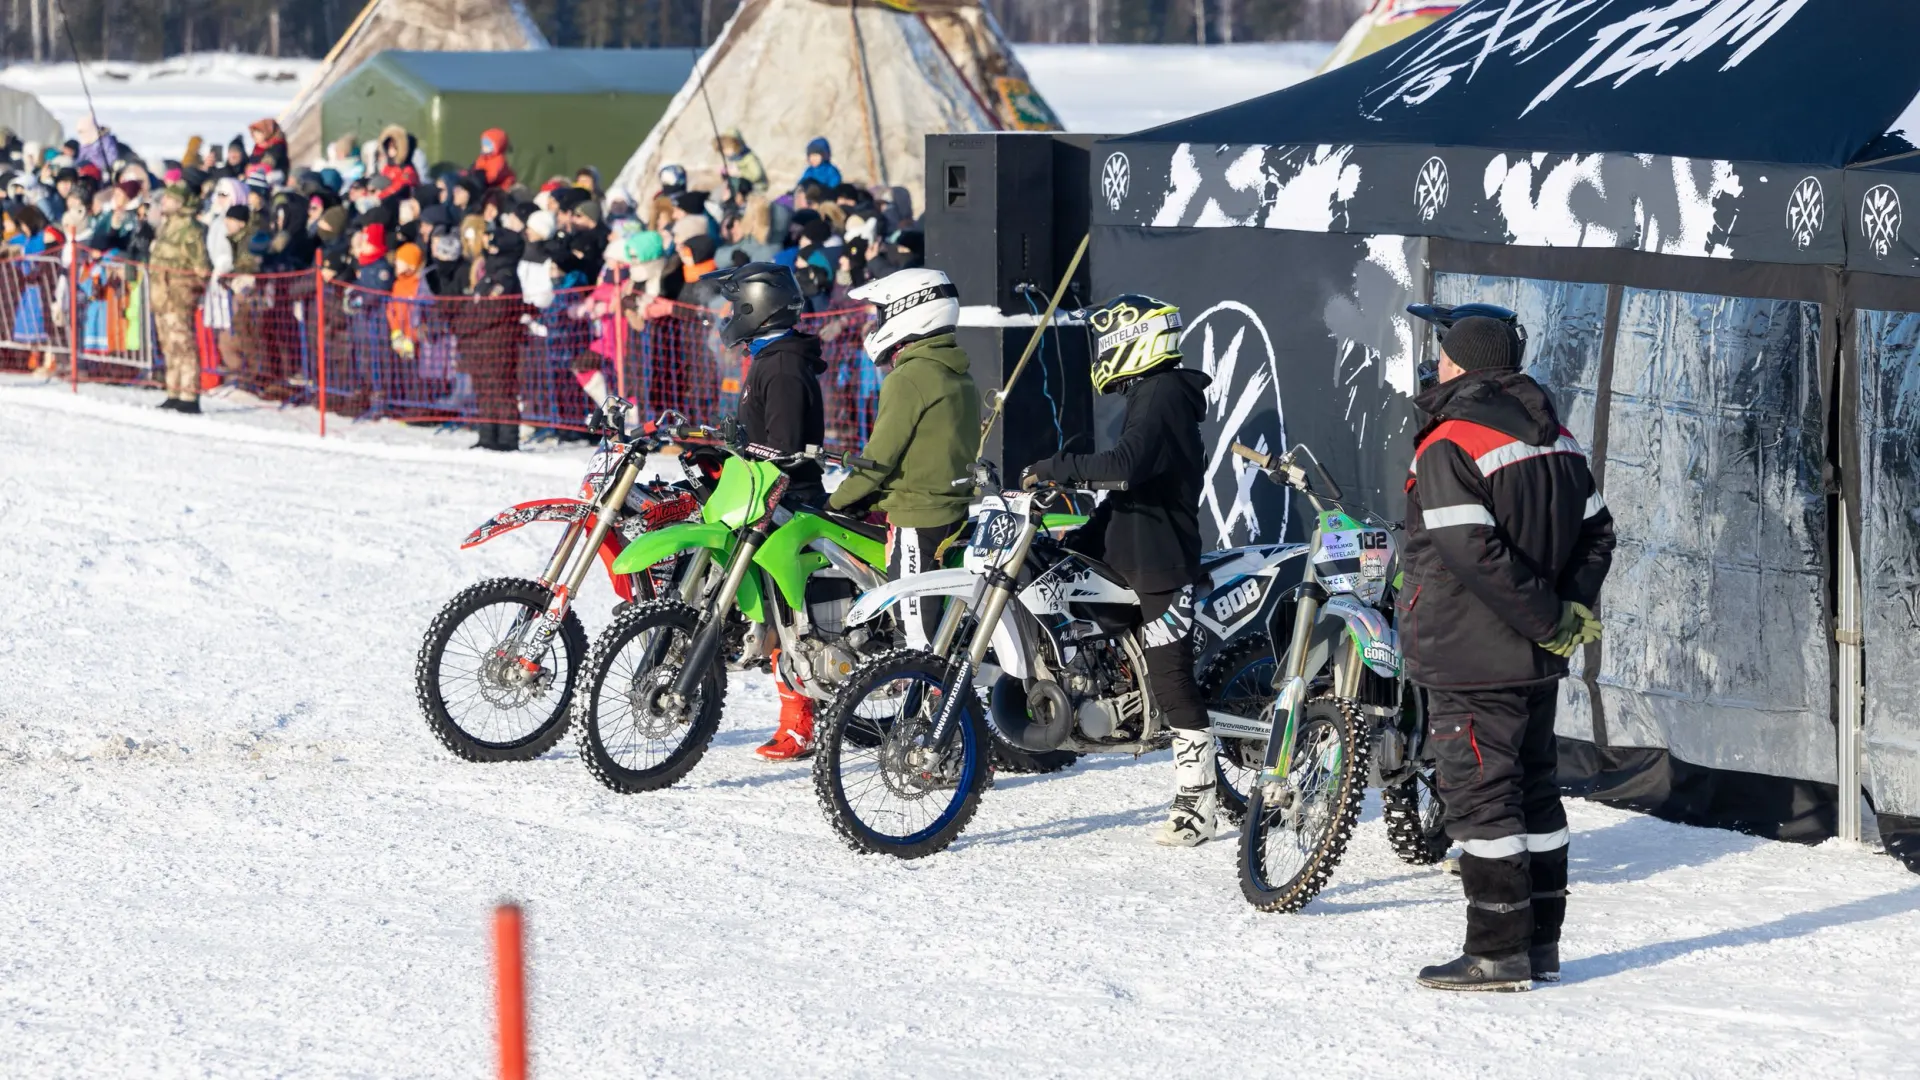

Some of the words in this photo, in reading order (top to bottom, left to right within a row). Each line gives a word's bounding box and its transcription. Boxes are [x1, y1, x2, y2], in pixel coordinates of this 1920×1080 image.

[1518, 0, 1803, 119] TEAM
[884, 288, 937, 320] 100%
[1356, 531, 1388, 550] 102
[1212, 577, 1261, 622] 808
[933, 660, 970, 740] WWW.FMX13.COM
